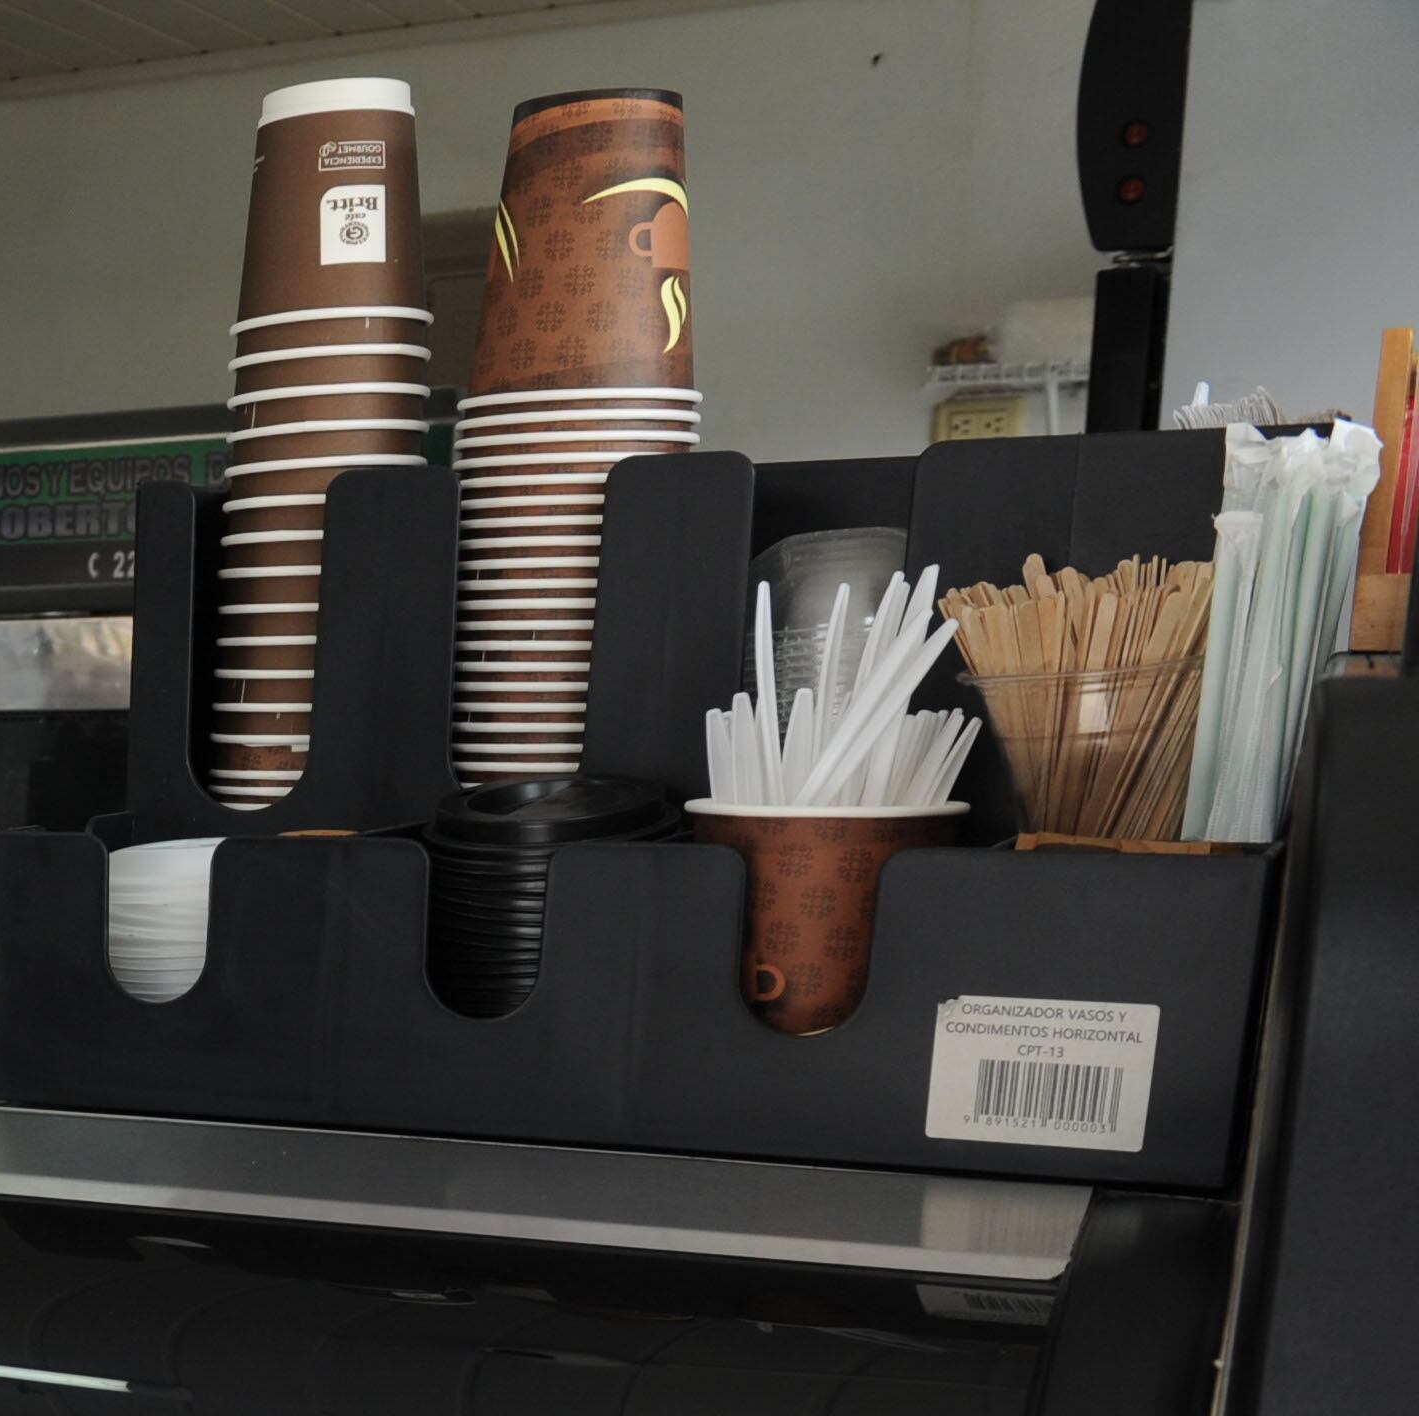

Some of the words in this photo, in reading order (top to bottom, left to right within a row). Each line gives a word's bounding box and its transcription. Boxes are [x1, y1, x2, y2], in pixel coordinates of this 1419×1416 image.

[42, 462, 62, 497] Y
[961, 1002, 1064, 1020] ORGANIZADOR
[1068, 1008, 1114, 1022] VASOS
[1117, 1011, 1128, 1023] Y
[945, 1021, 1049, 1039] CONDIMENTOS
[1052, 1026, 1144, 1044] HORIZONTAL
[1016, 1044, 1065, 1058] CPT-13
